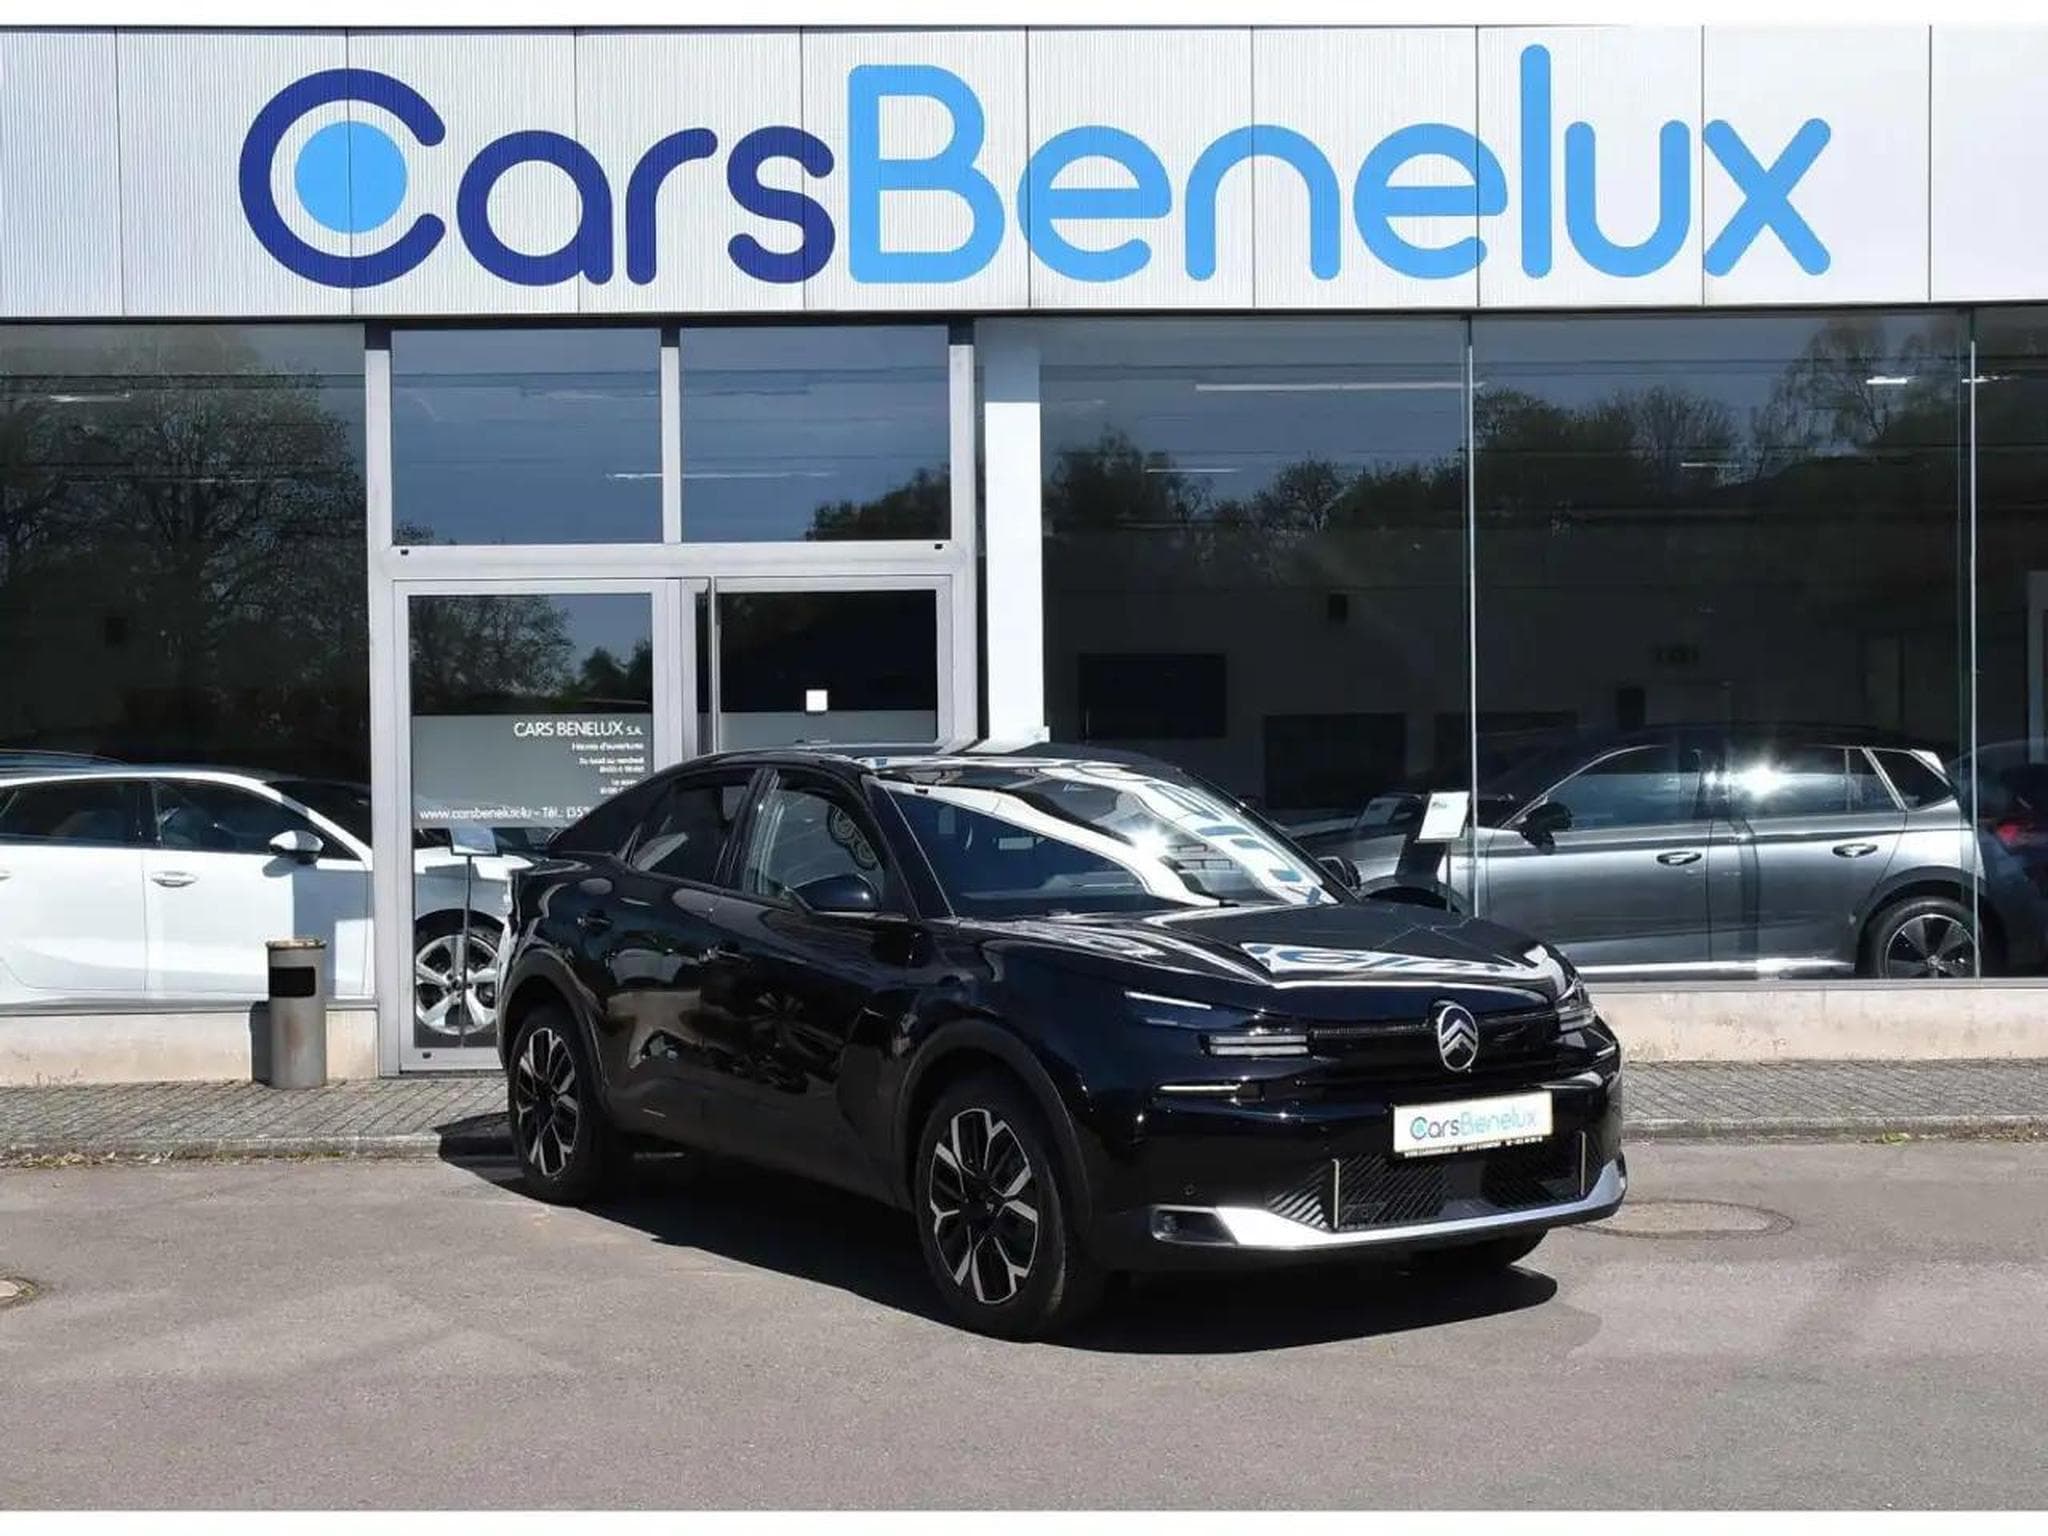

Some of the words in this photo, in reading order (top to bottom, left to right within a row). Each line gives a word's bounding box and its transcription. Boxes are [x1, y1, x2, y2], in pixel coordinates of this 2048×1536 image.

[239, 43, 1832, 289] CarsBenelux
[513, 721, 554, 737] CARS
[556, 720, 624, 736] BENELUX
[1410, 1105, 1537, 1140] CarsBenelux
